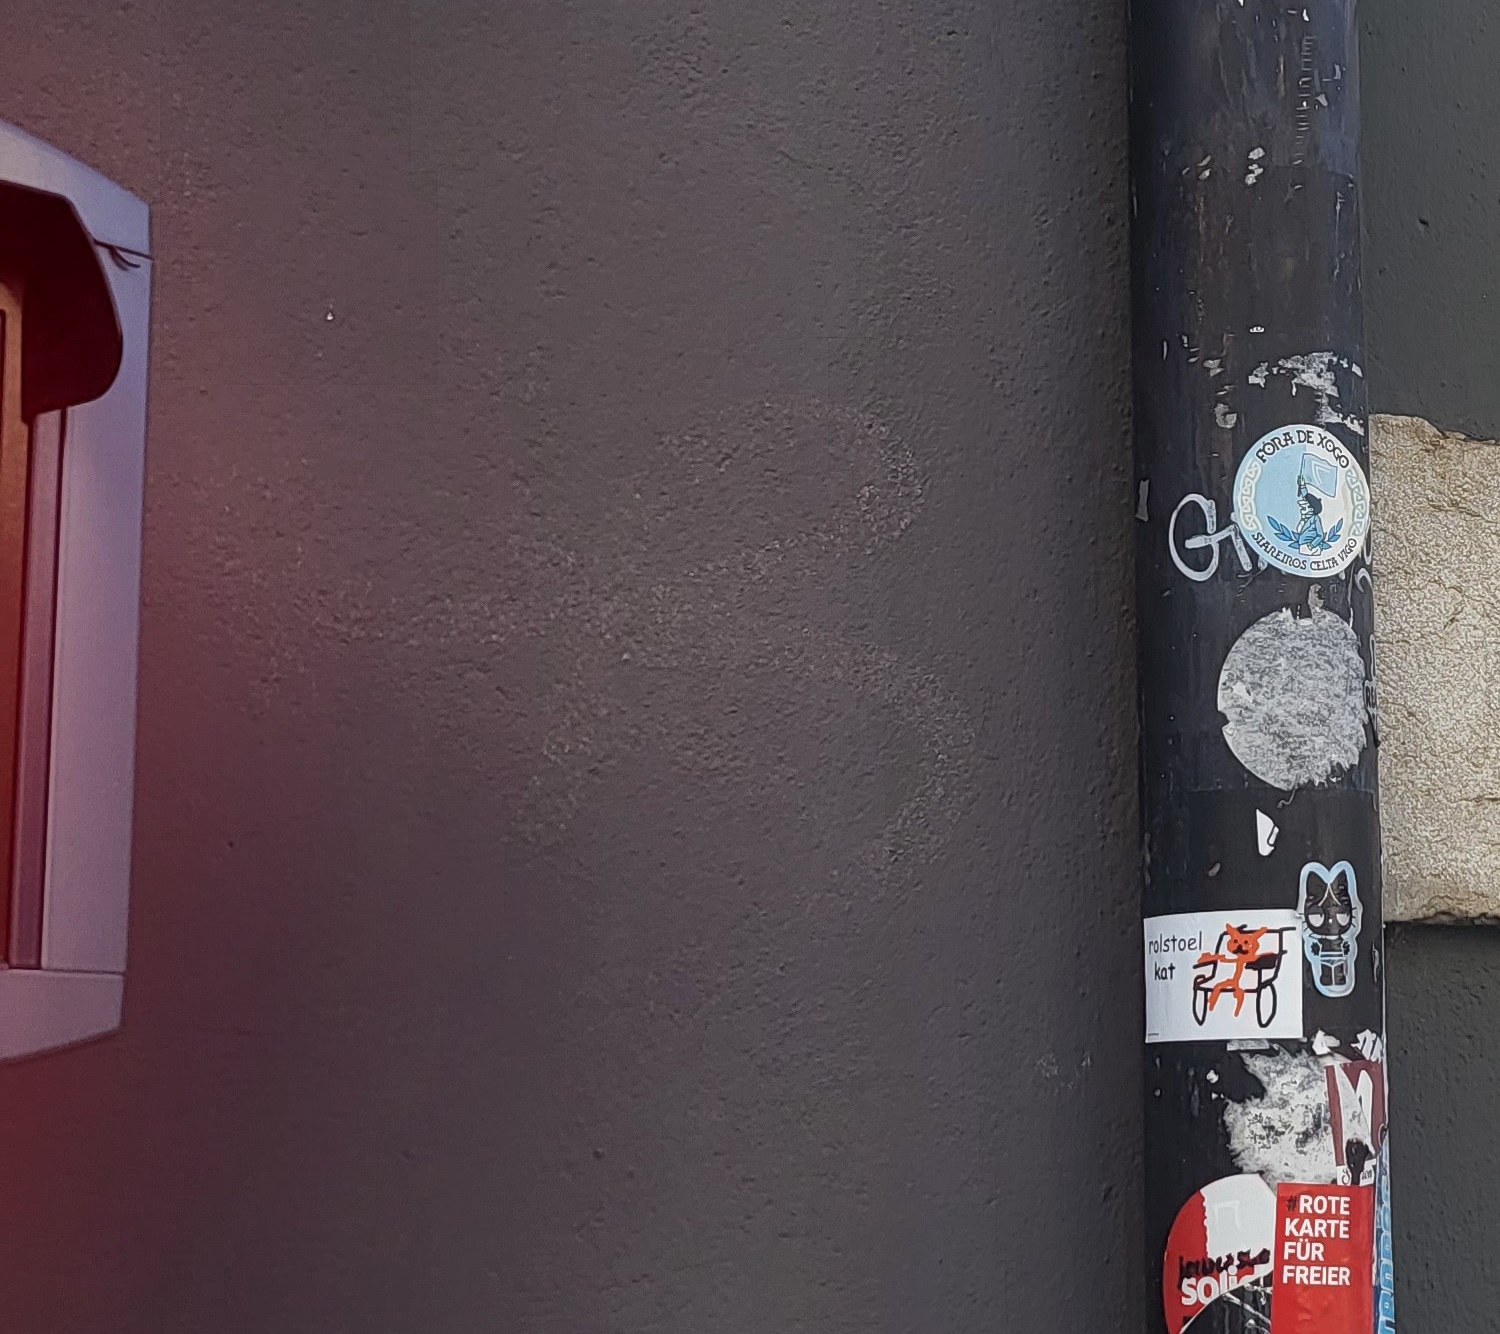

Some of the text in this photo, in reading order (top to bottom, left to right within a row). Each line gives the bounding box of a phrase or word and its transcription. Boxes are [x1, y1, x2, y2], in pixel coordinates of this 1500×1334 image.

[1296, 430, 1314, 445] DE
[1317, 433, 1350, 468] XOGO
[1252, 531, 1358, 571] SIAREIROS CELTA VIGO
[1148, 931, 1203, 956] rolstoel
[1154, 962, 1176, 981] kat
[1284, 1217, 1350, 1239] KARTE
[1283, 1238, 1325, 1262] FÜR
[1281, 1265, 1351, 1286] FREIER
